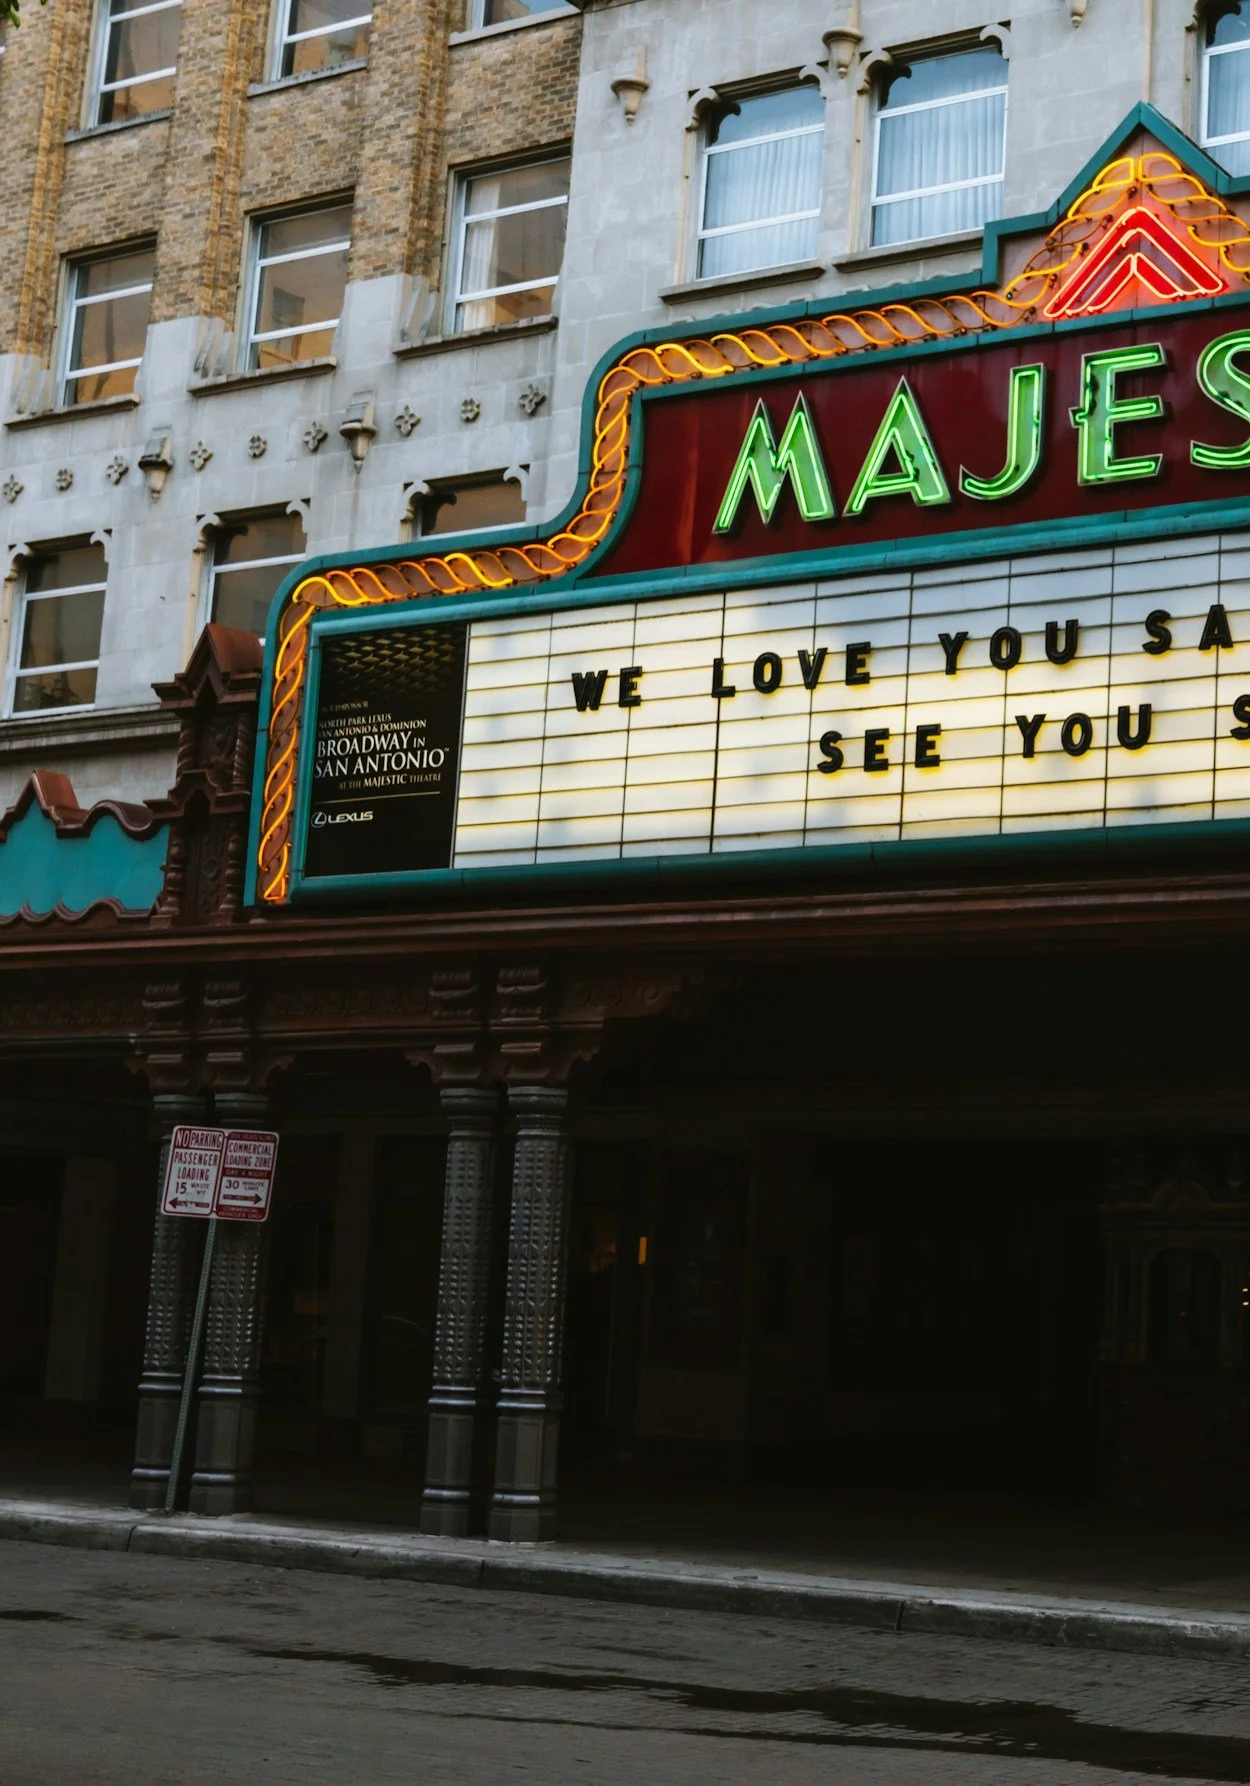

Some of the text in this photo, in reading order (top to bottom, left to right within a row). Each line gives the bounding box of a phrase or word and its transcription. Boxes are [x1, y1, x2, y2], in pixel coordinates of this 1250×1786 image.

[571, 665, 643, 712] WE
[711, 641, 871, 699] LOVE
[938, 618, 1080, 676] YOU
[333, 724, 371, 737] ANTONIO
[372, 723, 379, 733] &
[380, 719, 427, 733] DOMINION
[348, 716, 367, 727] PARK
[368, 713, 392, 724] LEXUS
[317, 731, 426, 758] BROADWAY IN
[817, 722, 942, 774] SEE
[1015, 702, 1153, 759] YOU
[314, 758, 349, 779] SAN
[363, 773, 408, 789] MAJESTIC
[328, 810, 374, 824] LEXUS
[175, 1130, 223, 1150] NO PARKING
[229, 1142, 273, 1157] COMMERCIAL
[174, 1151, 219, 1167] PASSENGER
[226, 1155, 272, 1169] LOADING ZONE
[177, 1167, 210, 1181] LOADING
[175, 1182, 187, 1195] 15
[225, 1180, 240, 1190] 30
